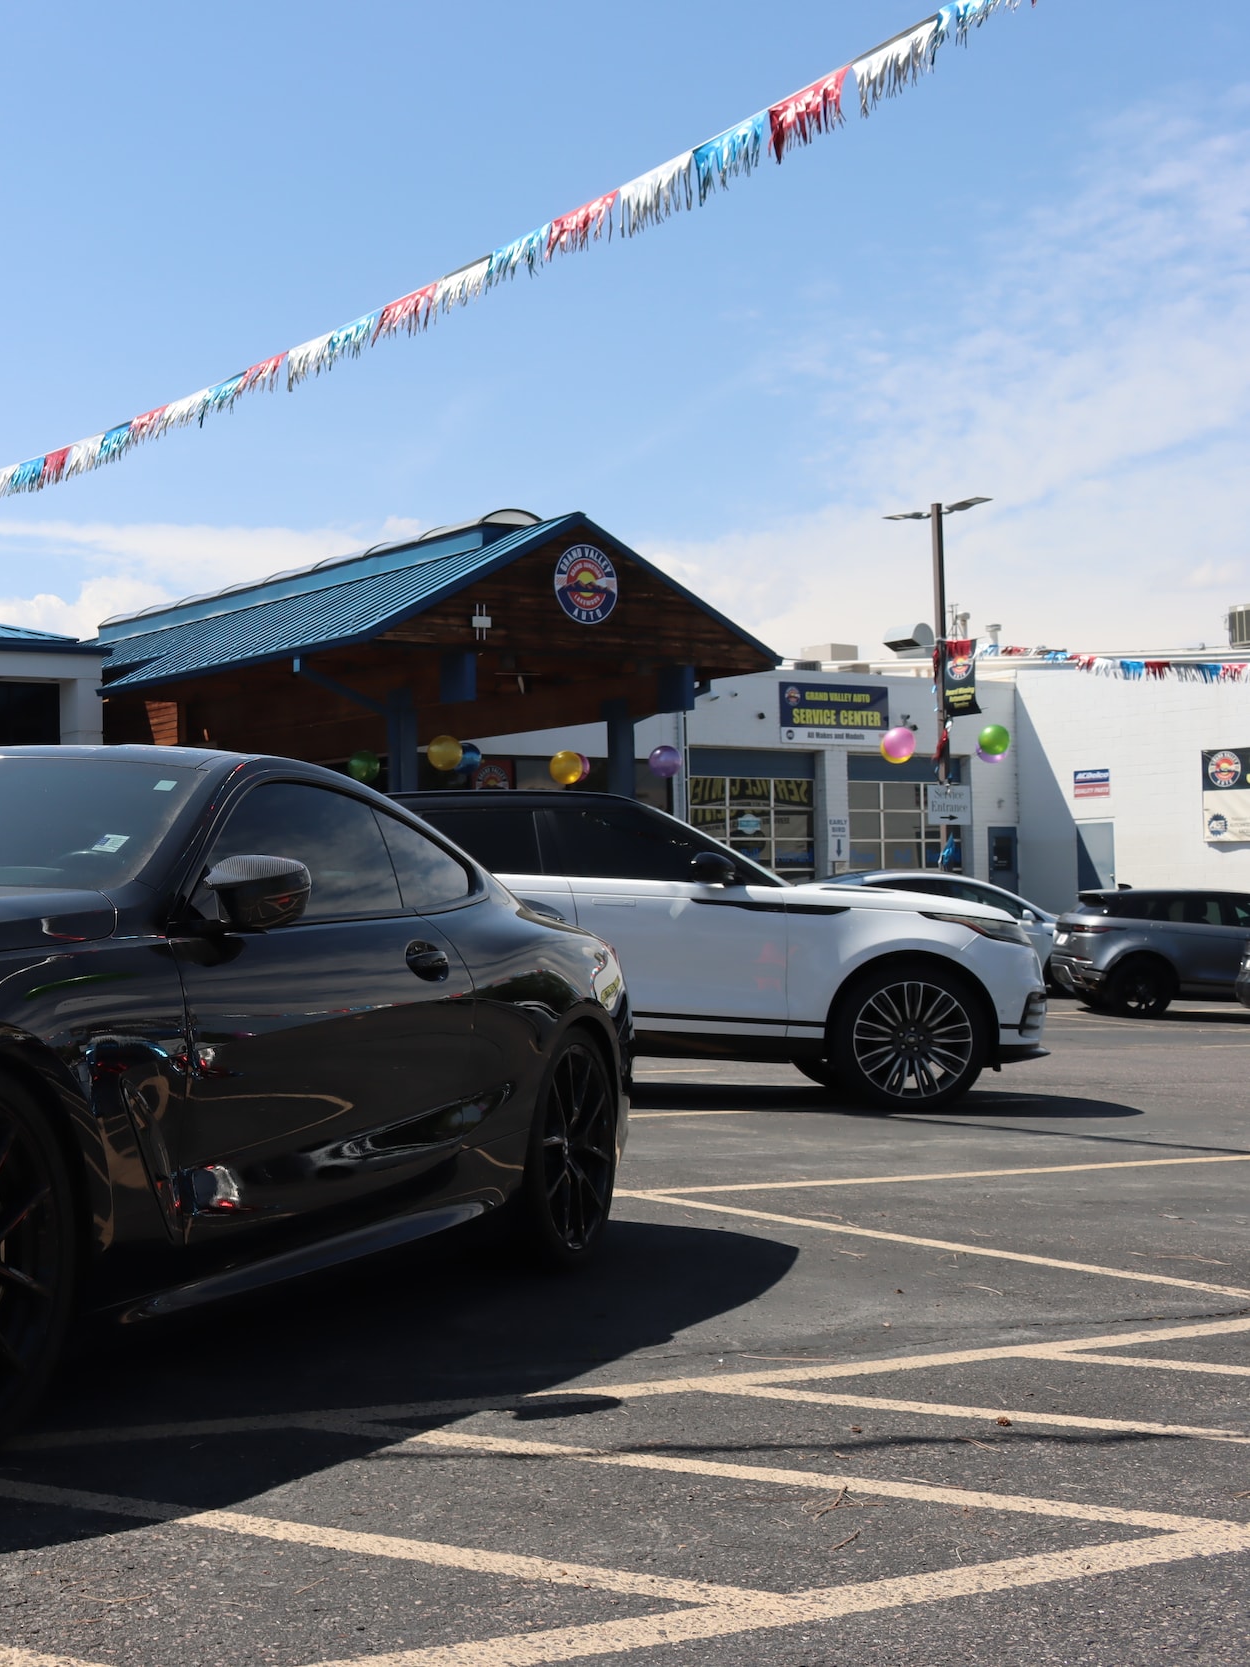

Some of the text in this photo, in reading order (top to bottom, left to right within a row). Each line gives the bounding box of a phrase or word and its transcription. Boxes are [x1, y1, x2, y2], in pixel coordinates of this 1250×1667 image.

[560, 548, 612, 573] GRAND VALLEY
[572, 608, 602, 620] AUTO
[805, 691, 828, 701] GRAND
[829, 692, 852, 702] VALLEY
[852, 693, 871, 703] AUTO
[792, 708, 881, 726] SERVICE CENTER
[845, 732, 865, 740] Models
[1075, 771, 1109, 780] ACDelco
[934, 788, 965, 799] Service
[931, 800, 968, 812] Entrance
